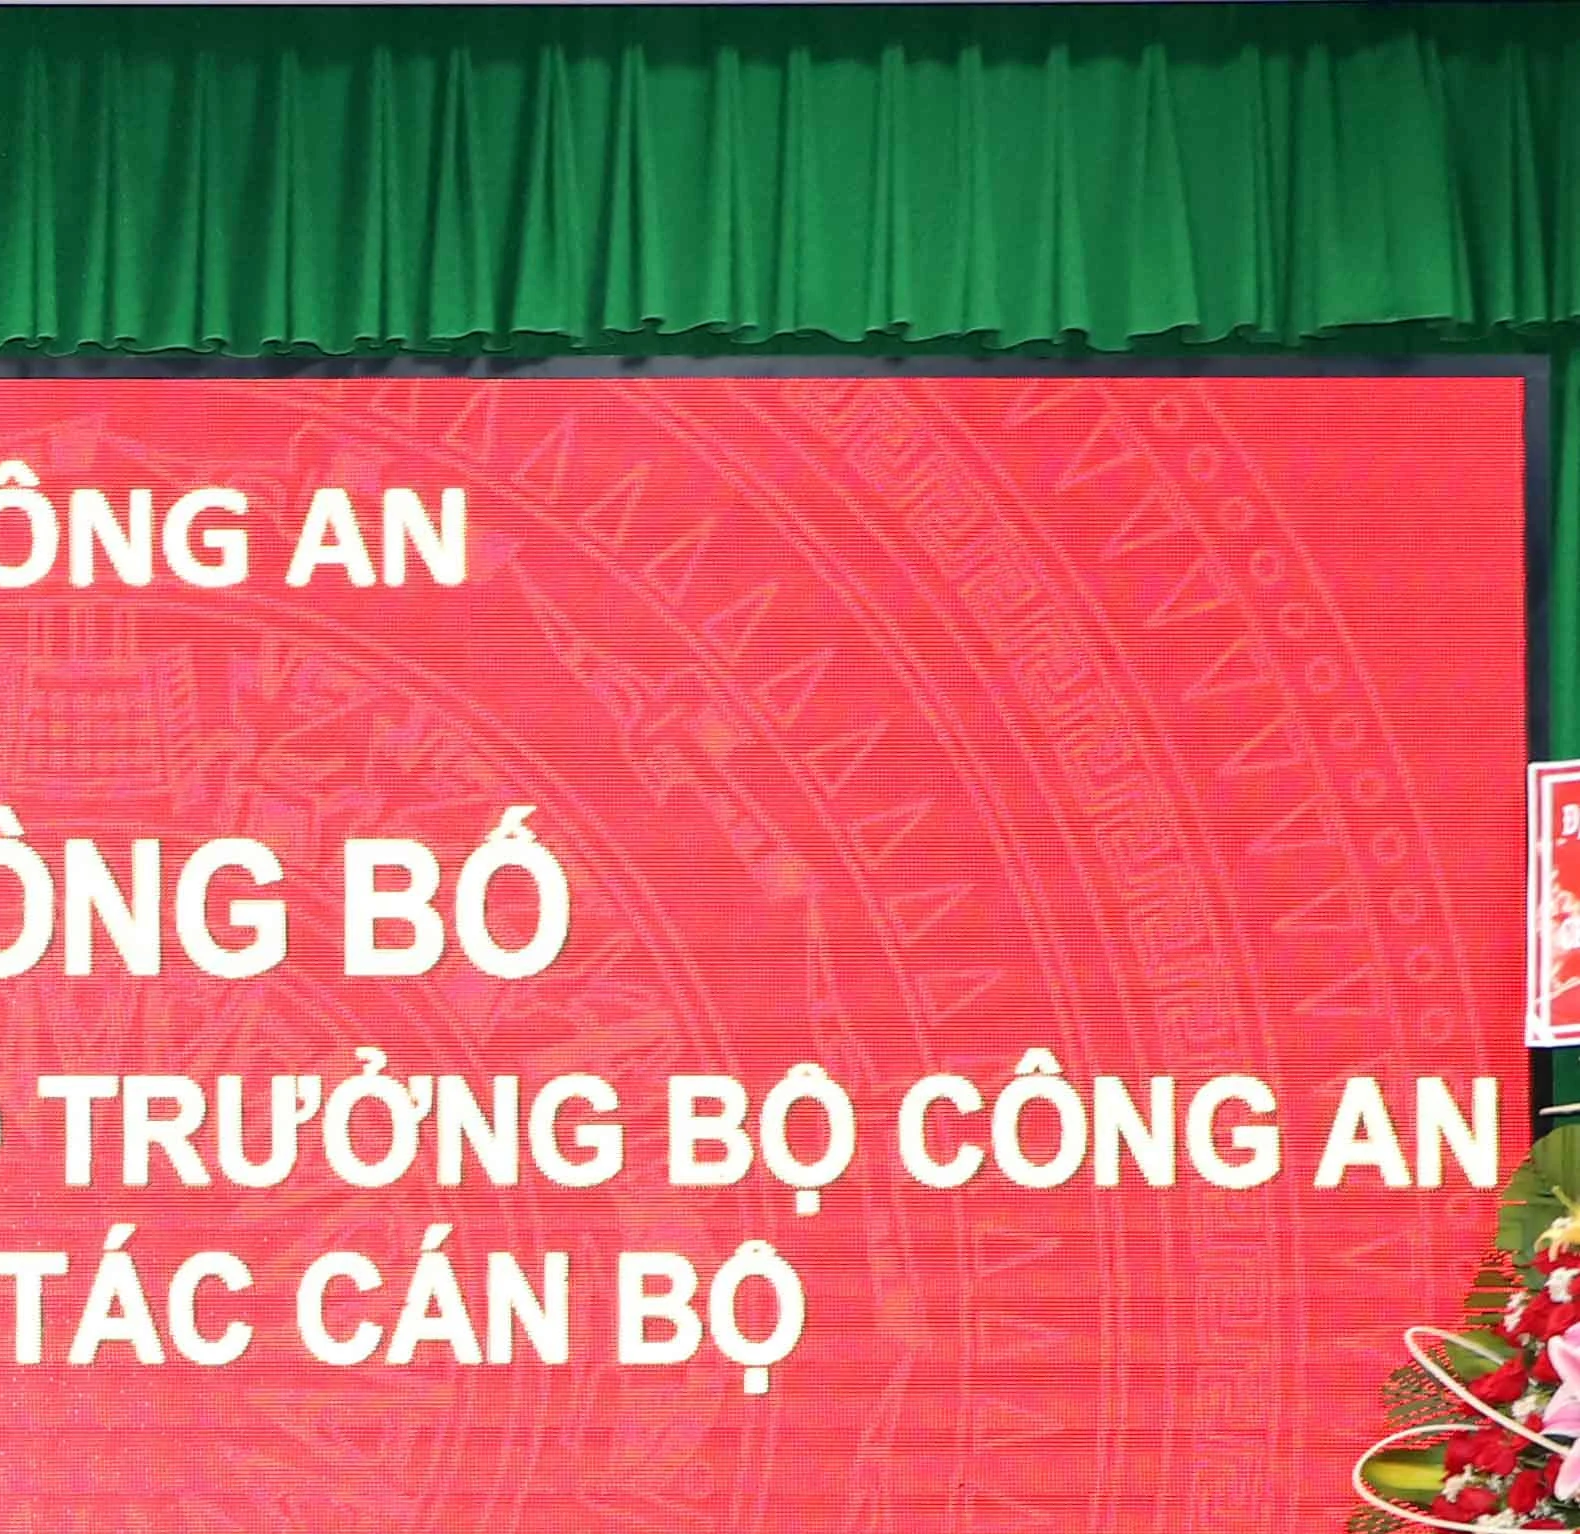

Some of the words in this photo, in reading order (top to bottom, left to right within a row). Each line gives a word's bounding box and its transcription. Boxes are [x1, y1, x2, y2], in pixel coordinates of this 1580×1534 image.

[285, 487, 468, 588] AN
[343, 804, 570, 980] BỐ
[37, 1044, 624, 1189] TRƯỞNG
[667, 1060, 857, 1215] BỘ
[897, 1046, 1281, 1190] CÔNG
[1313, 1075, 1498, 1189] AN
[295, 1222, 571, 1367] CÁN
[616, 1237, 808, 1396] BỘ
